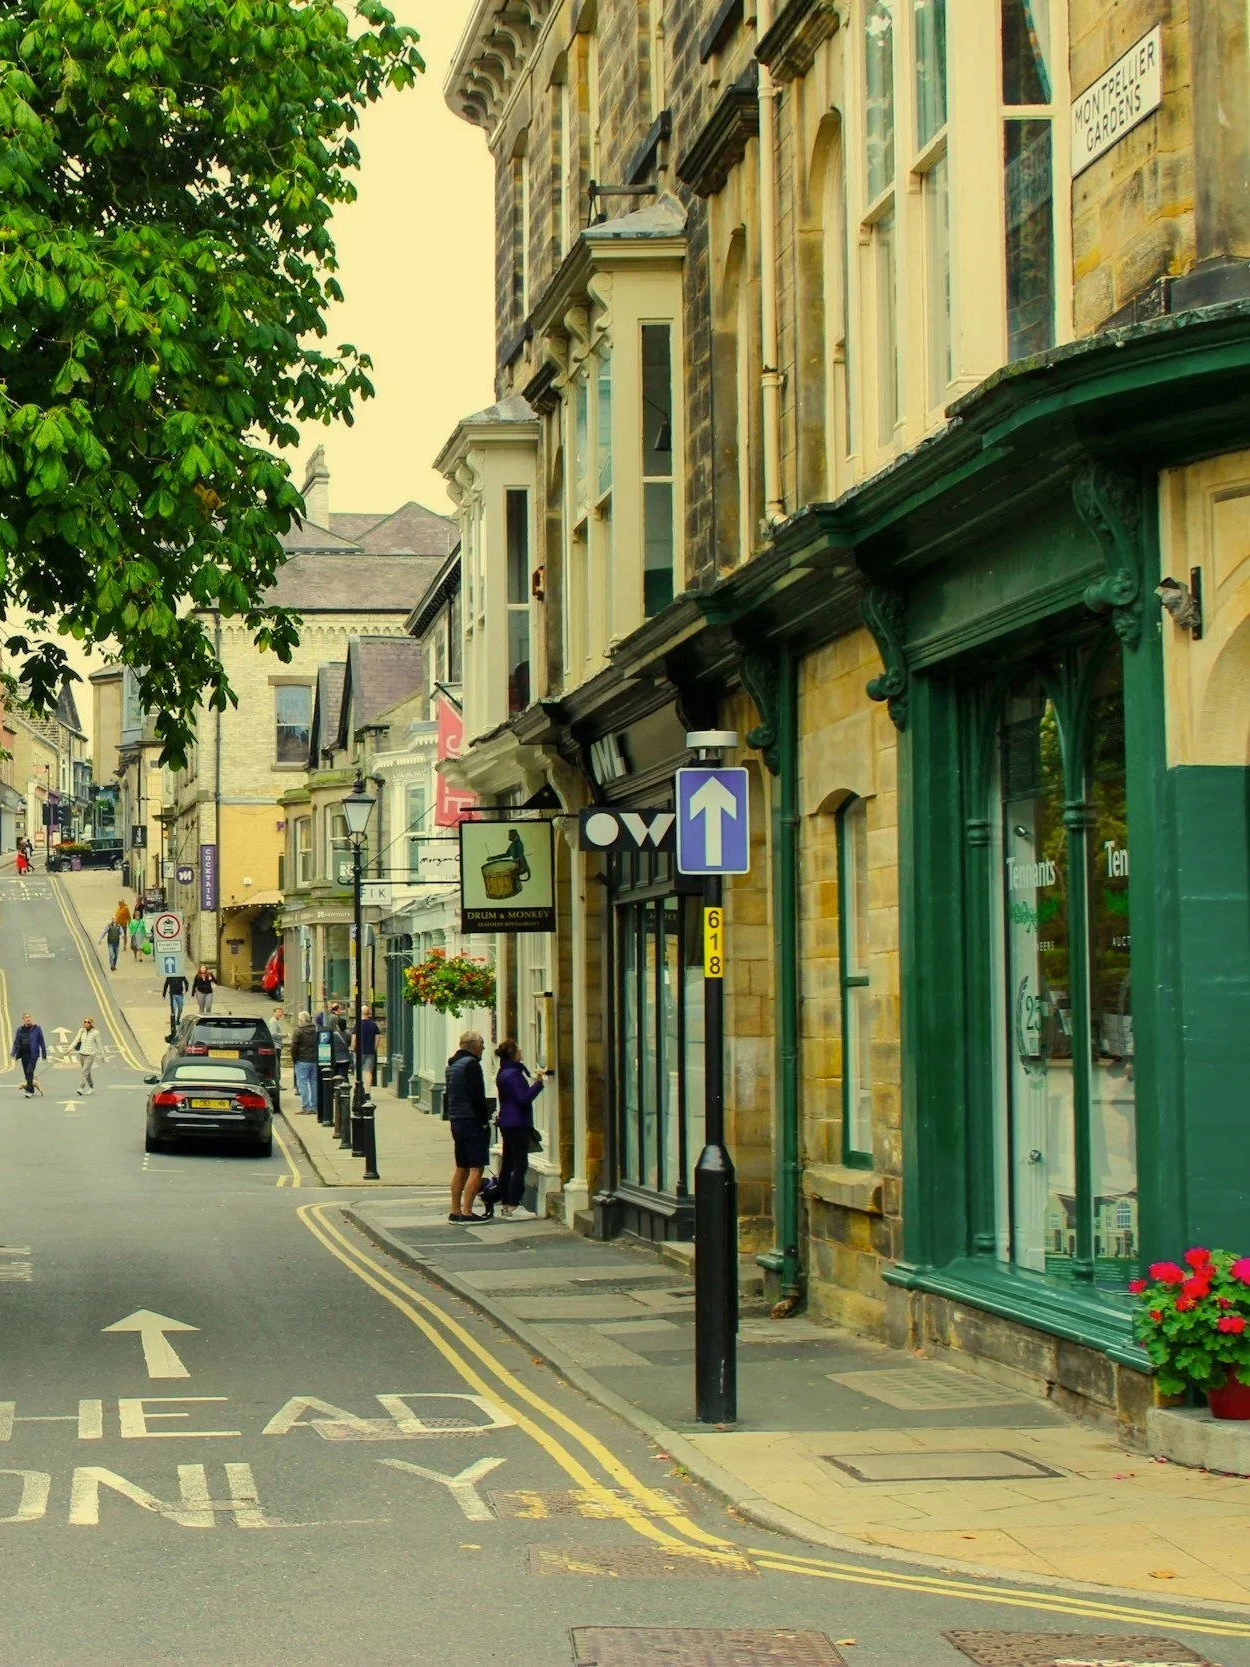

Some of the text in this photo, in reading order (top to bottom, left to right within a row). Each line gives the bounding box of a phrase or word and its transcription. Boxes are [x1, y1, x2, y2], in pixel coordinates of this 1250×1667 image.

[1075, 41, 1155, 134] MONTPELLIER
[1086, 84, 1141, 152] GARDENS
[591, 733, 627, 786] OWL
[585, 812, 676, 848] OW
[420, 857, 454, 866] Morgan
[1006, 857, 1056, 890] Tennants
[1105, 840, 1129, 877] Ten
[467, 912, 497, 920] DRUM
[508, 910, 550, 919] MONKEY
[707, 909, 721, 975] 618
[1112, 936, 1130, 947] AUCT
[320, 1032, 328, 1043] P
